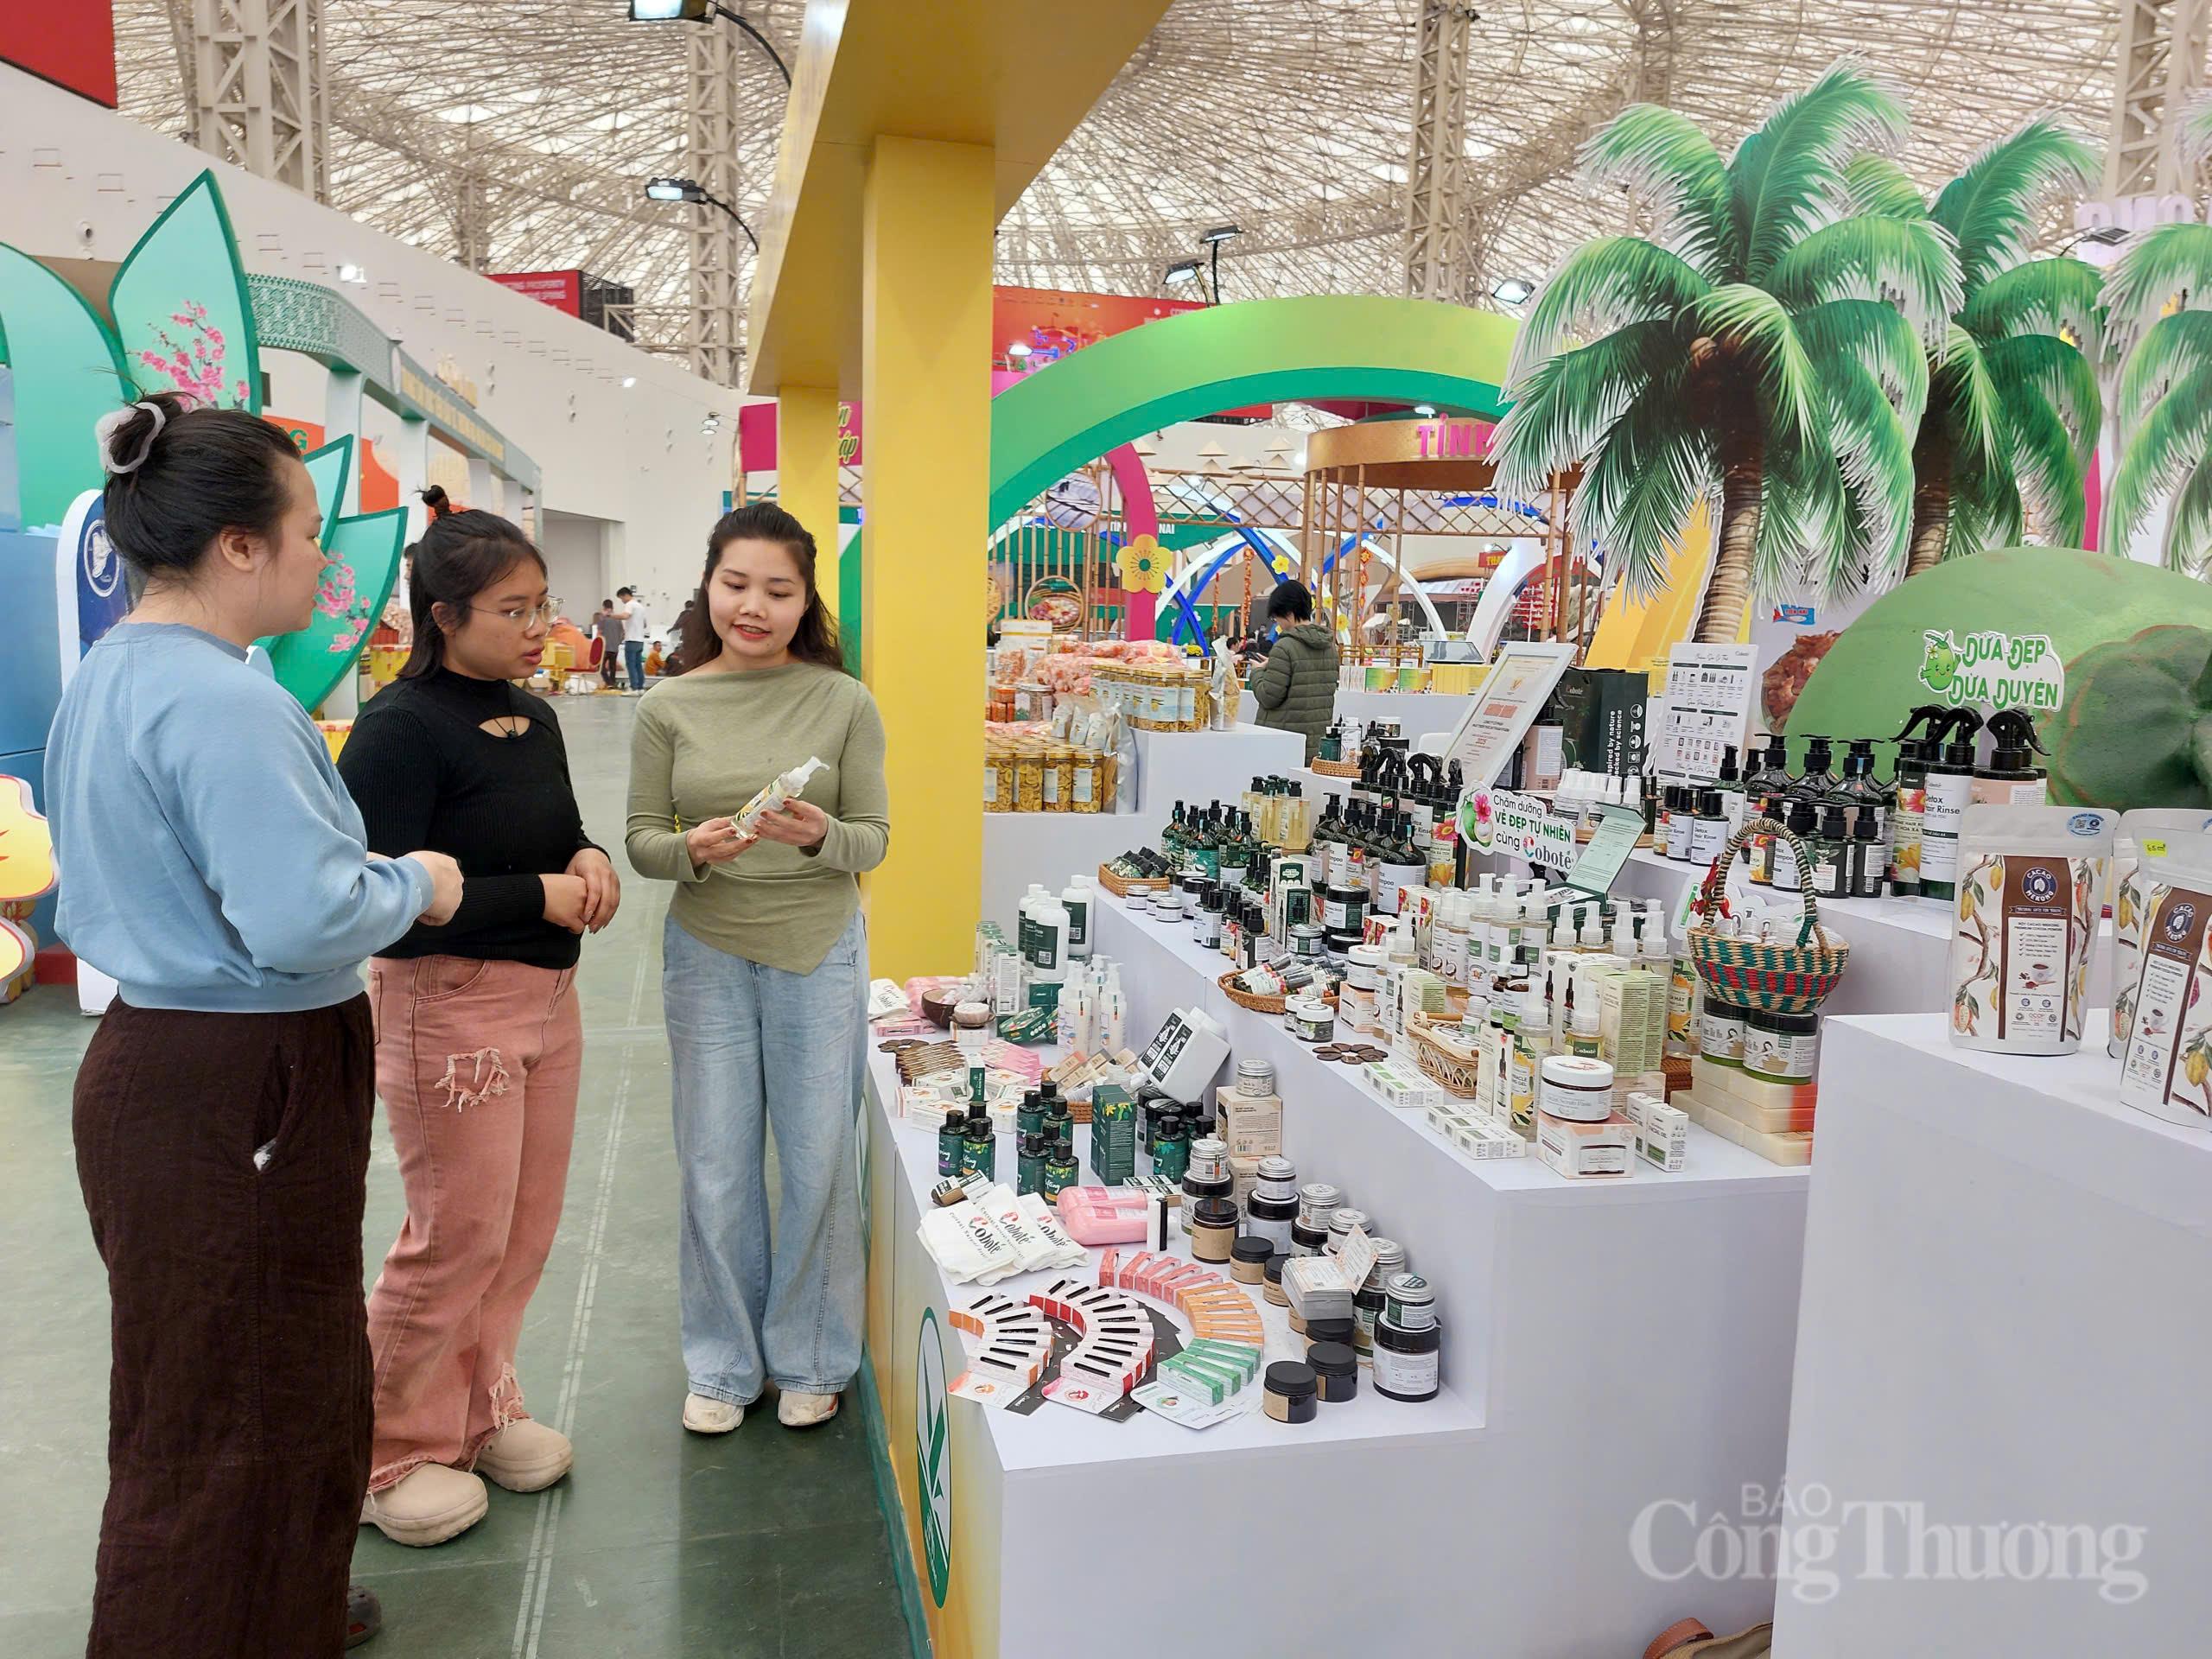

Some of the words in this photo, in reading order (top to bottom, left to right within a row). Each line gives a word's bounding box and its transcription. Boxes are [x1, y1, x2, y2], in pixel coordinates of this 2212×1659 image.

[1158, 523, 1175, 535] NAI
[2007, 639, 2046, 671] ĐẸP
[1993, 677, 2058, 710] DUYÊN
[1493, 794, 1516, 810] Chăm
[1518, 802, 1542, 819] dưỡng
[1936, 805, 1961, 815] Rinse
[1495, 809, 1507, 825] VẺ
[1509, 814, 1527, 833] ĐẸP
[1529, 819, 1542, 838] TỰ
[1543, 823, 1571, 843] NHIÊN
[1496, 831, 1520, 851] cùng
[1522, 836, 1573, 869] Coboté
[2026, 869, 2052, 879] CACAO
[2025, 889, 2054, 902] MEKONG
